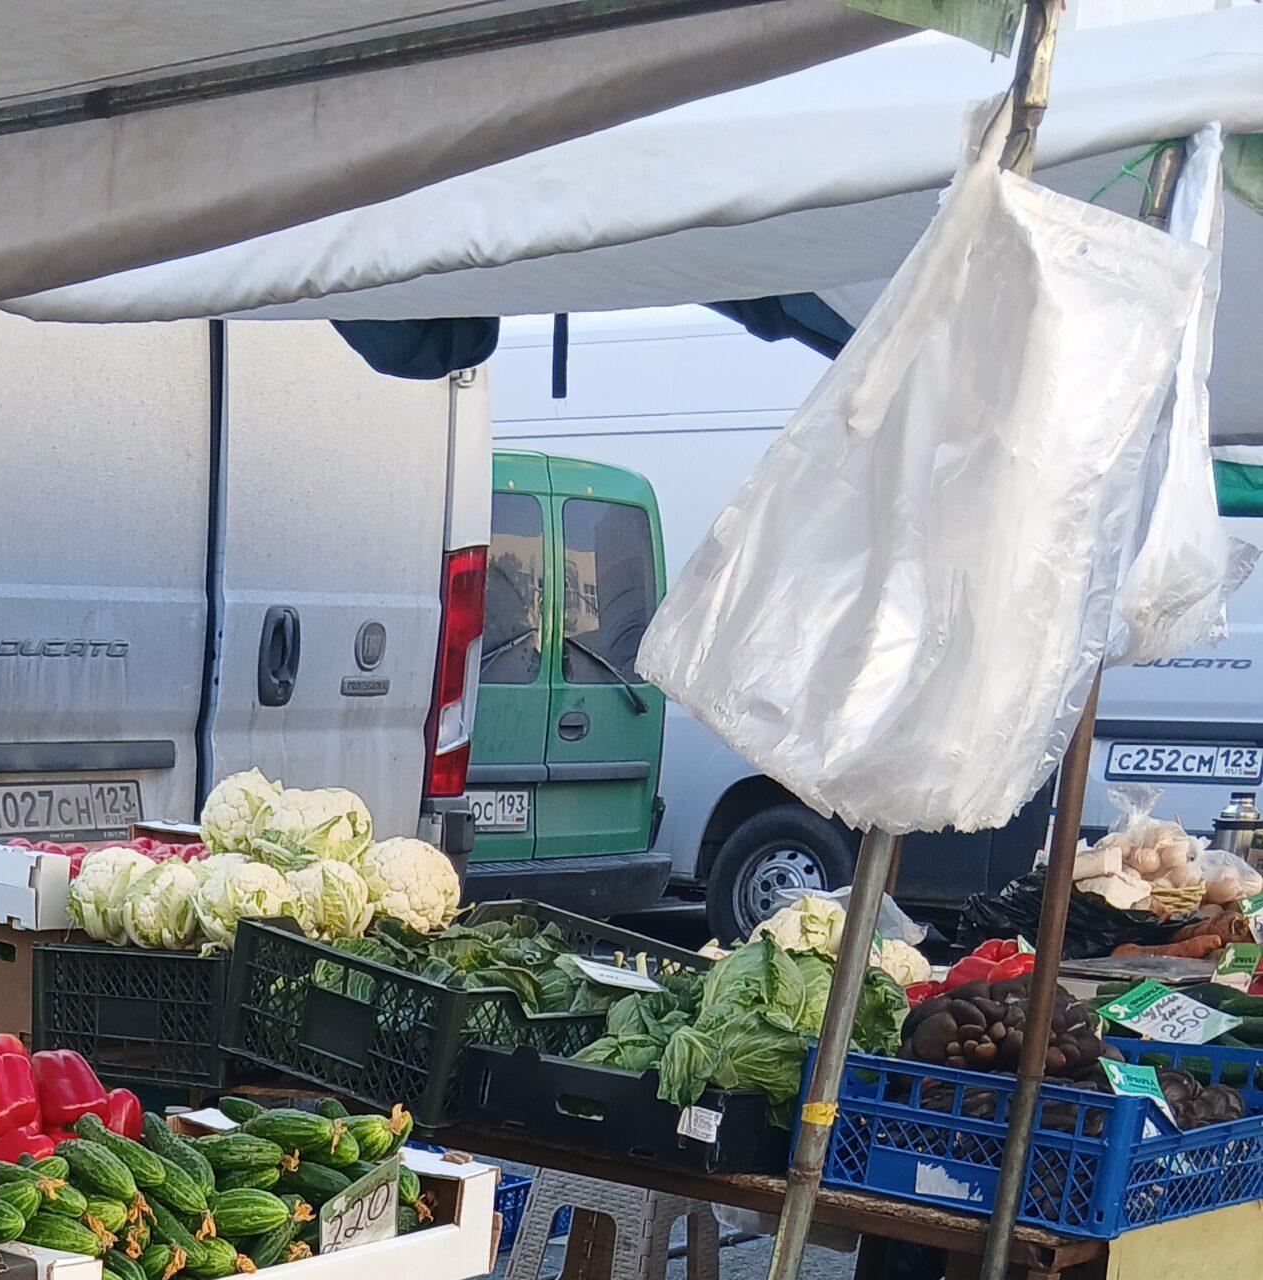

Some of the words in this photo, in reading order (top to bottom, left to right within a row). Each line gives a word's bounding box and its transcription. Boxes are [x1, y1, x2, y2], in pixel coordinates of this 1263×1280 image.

[1220, 749, 1258, 768] 123
[1225, 768, 1243, 776] RUS
[95, 786, 133, 815] 123
[468, 797, 494, 821] ОС
[498, 794, 526, 815] 193
[105, 814, 124, 825] RUS
[1160, 1006, 1211, 1040] 250
[322, 1182, 391, 1254] 220
